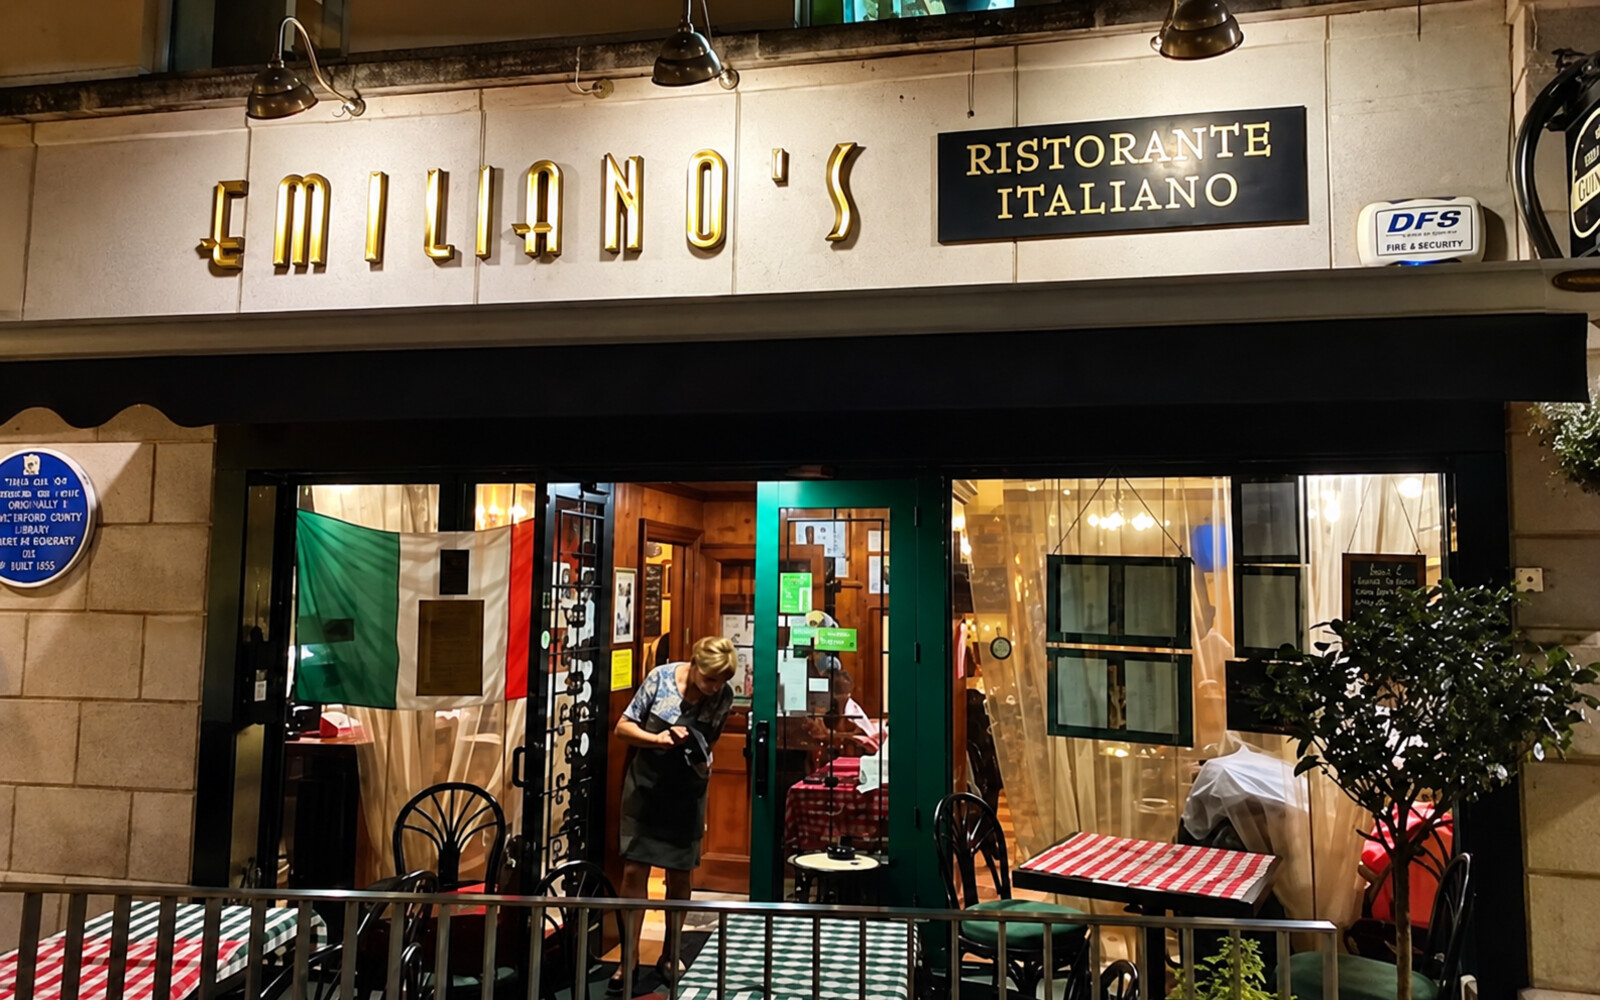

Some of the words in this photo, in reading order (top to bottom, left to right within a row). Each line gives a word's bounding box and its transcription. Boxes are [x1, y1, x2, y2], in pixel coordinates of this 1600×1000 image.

[966, 121, 1271, 176] RISTORANTE
[200, 143, 858, 269] EMILIANO'S
[997, 173, 1238, 219] ITALIANO
[1387, 210, 1461, 233] DFS
[1386, 243, 1406, 252] FIRE
[1410, 242, 1416, 250] &
[1418, 240, 1464, 250] SECURITY
